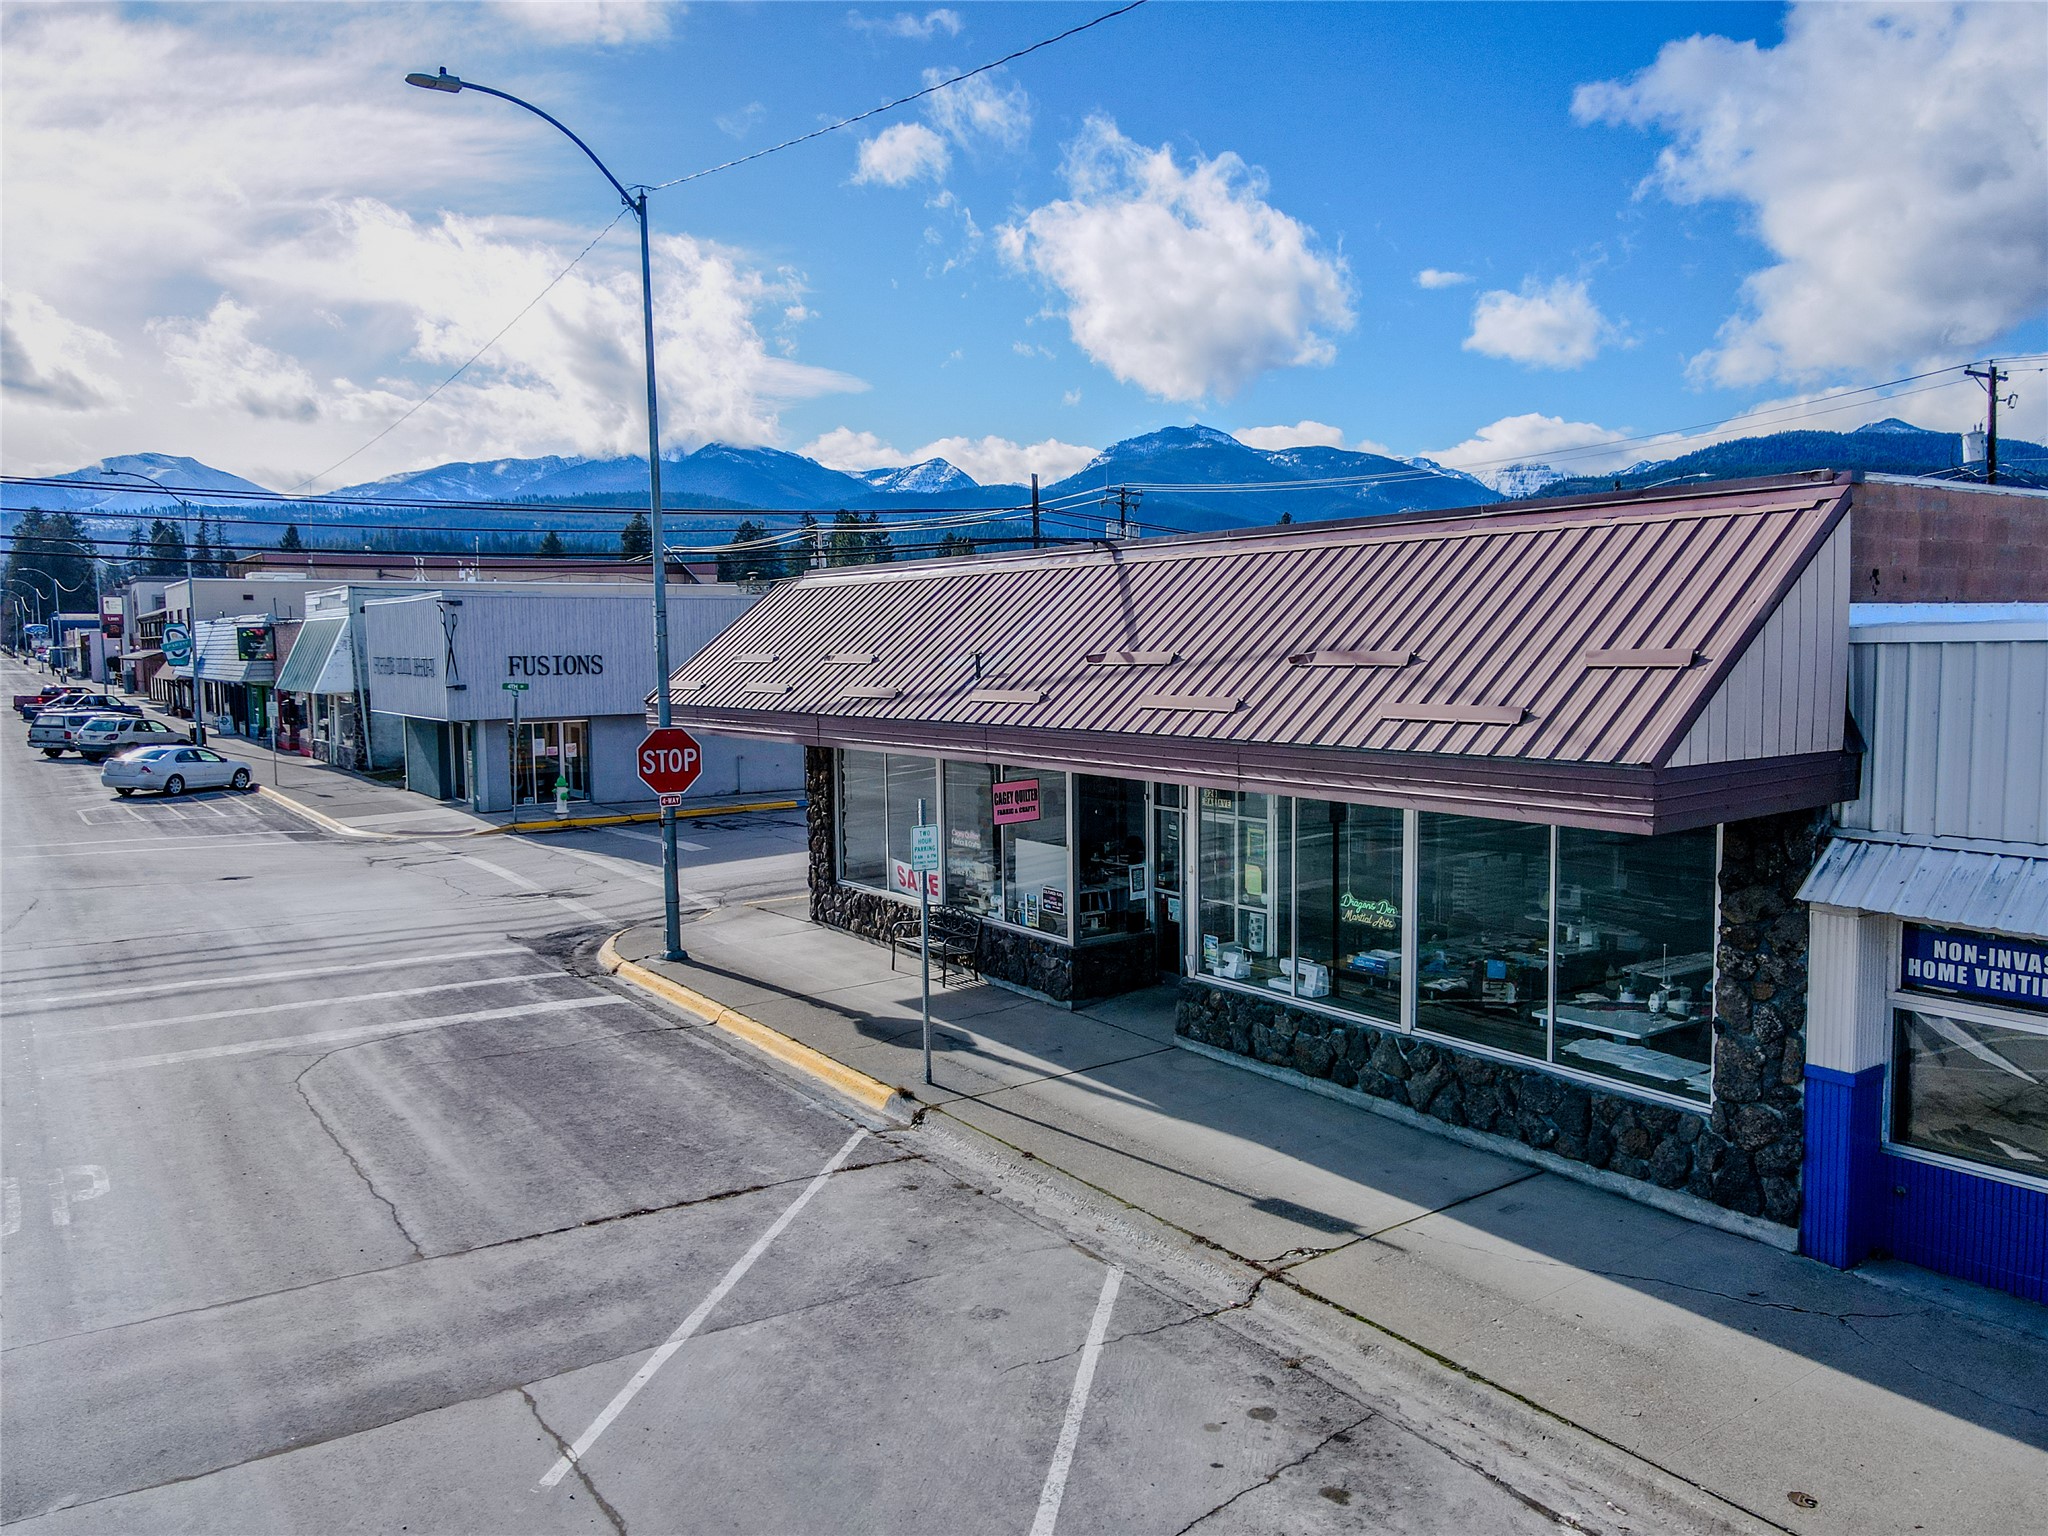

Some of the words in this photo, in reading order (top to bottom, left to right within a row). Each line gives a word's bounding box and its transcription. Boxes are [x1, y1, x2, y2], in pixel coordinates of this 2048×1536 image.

[508, 655, 603, 676] FUSIONS
[642, 748, 697, 774] STOP
[662, 797, 680, 805] 4-WAY
[1015, 788, 1037, 804] QUILTER
[1341, 893, 1377, 914] Dragons
[1376, 900, 1396, 915] Den
[1342, 909, 1373, 924] Martial
[1372, 915, 1395, 928] Arts
[1908, 957, 1968, 985] HOME
